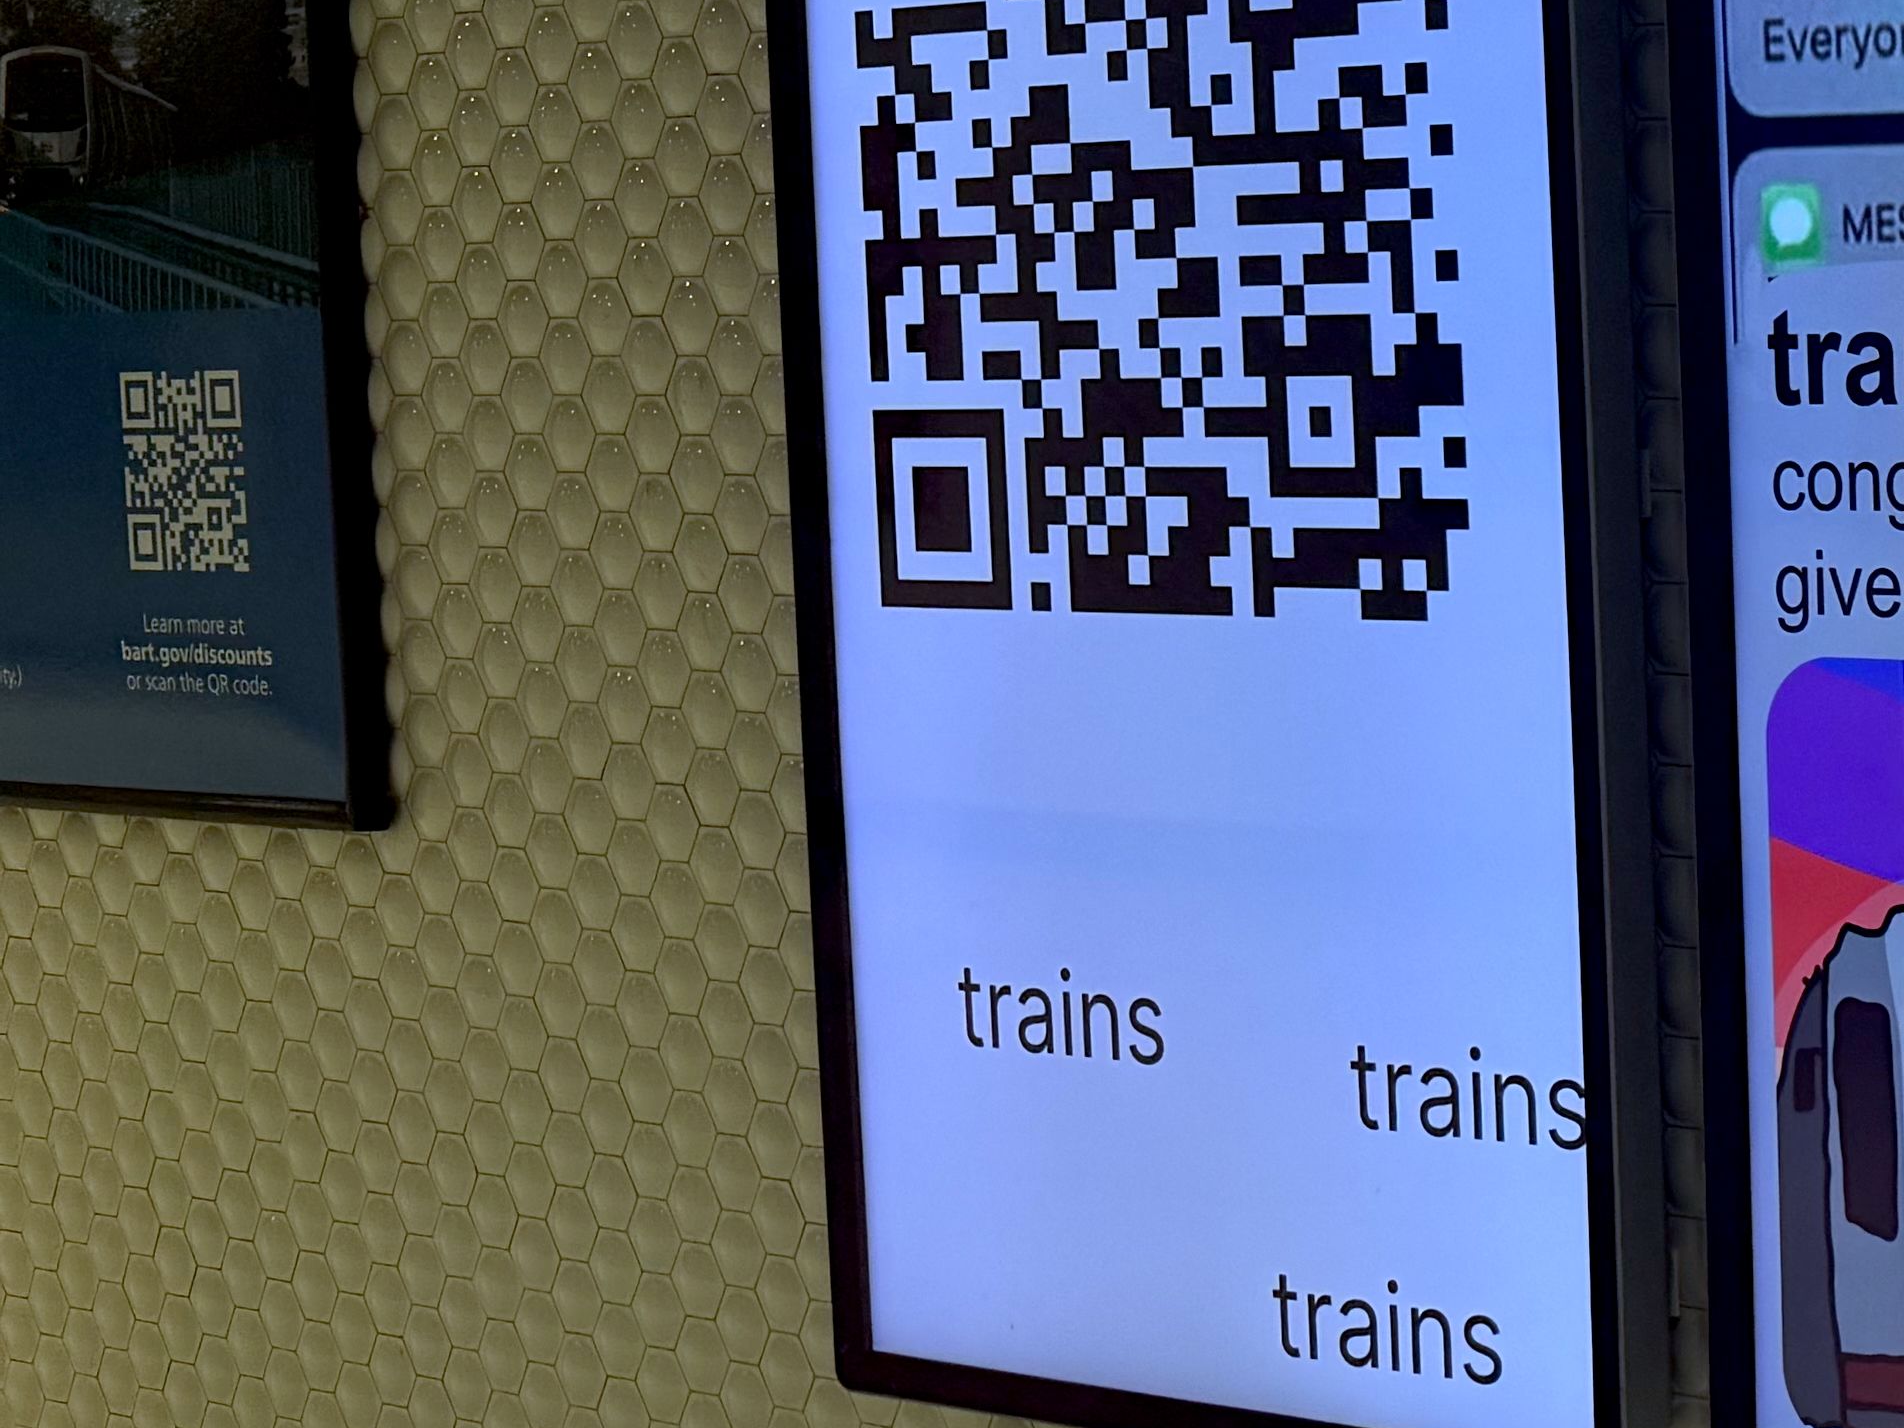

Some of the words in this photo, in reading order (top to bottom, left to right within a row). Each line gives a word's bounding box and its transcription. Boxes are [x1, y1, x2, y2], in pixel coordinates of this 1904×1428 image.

[120, 639, 273, 667] bart.gov/discounts
[142, 611, 184, 634] Learn
[186, 617, 225, 635] more
[228, 617, 245, 636] at
[126, 674, 141, 690] or
[144, 675, 176, 692] scan
[179, 671, 204, 693] the
[207, 673, 230, 695] QR
[232, 674, 273, 696] code.
[959, 968, 1163, 1065] trains
[1350, 1045, 1587, 1151] trains
[1273, 1275, 1501, 1384] trains
